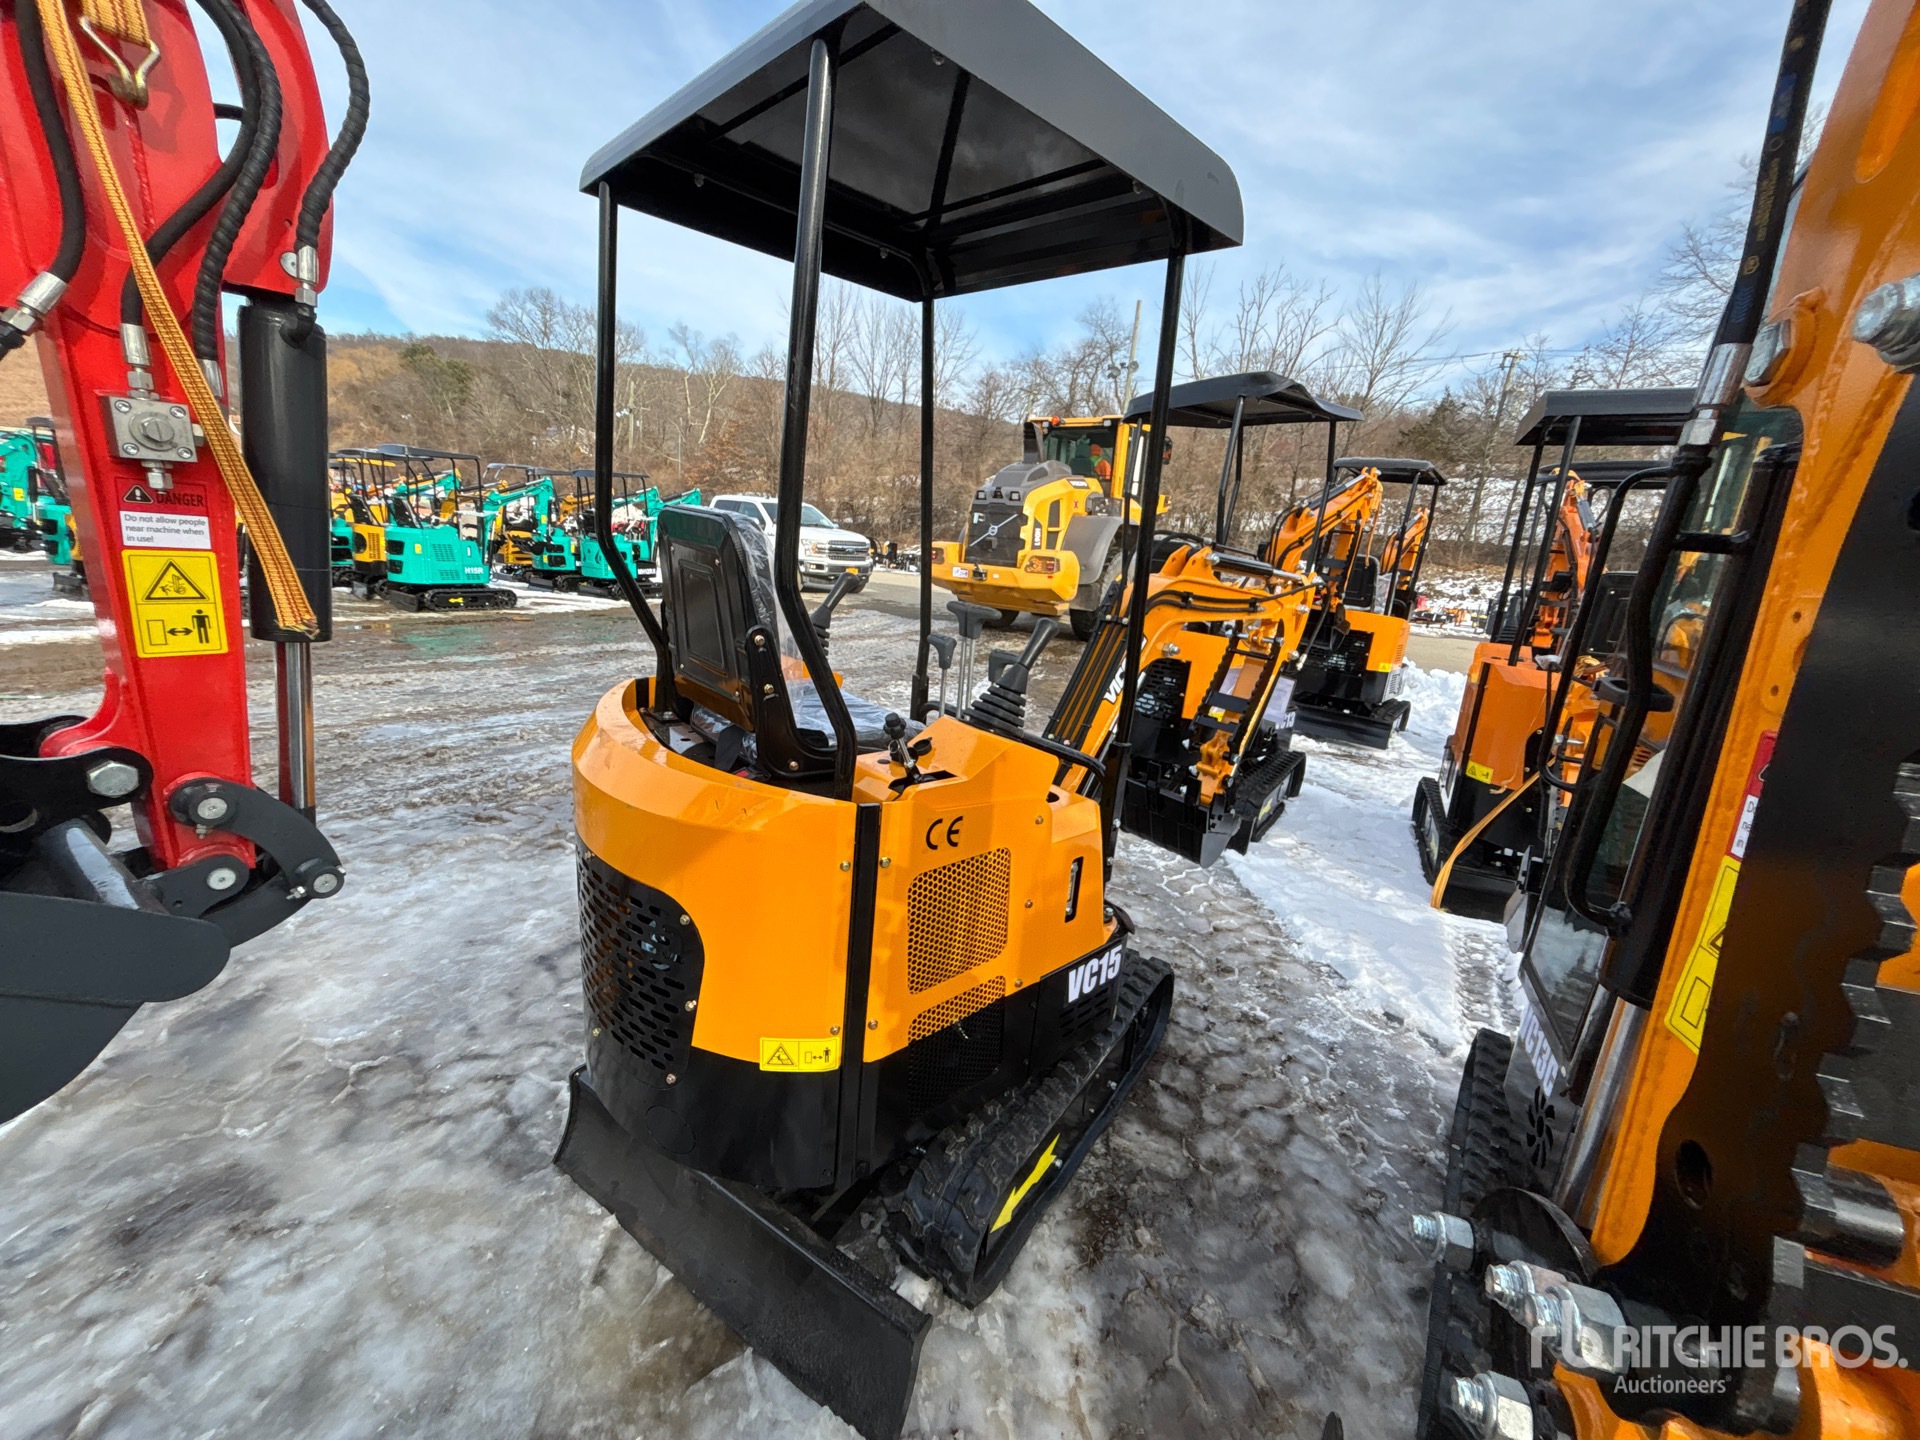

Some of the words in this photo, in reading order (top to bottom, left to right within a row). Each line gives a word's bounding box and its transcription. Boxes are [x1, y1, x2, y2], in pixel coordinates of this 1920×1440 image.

[156, 491, 204, 507] DANGER
[124, 514, 137, 522] Do
[155, 516, 177, 524] allow
[179, 518, 206, 527] people
[146, 526, 181, 535] machine
[926, 816, 963, 850] CE
[1068, 945, 1122, 1003] VC15
